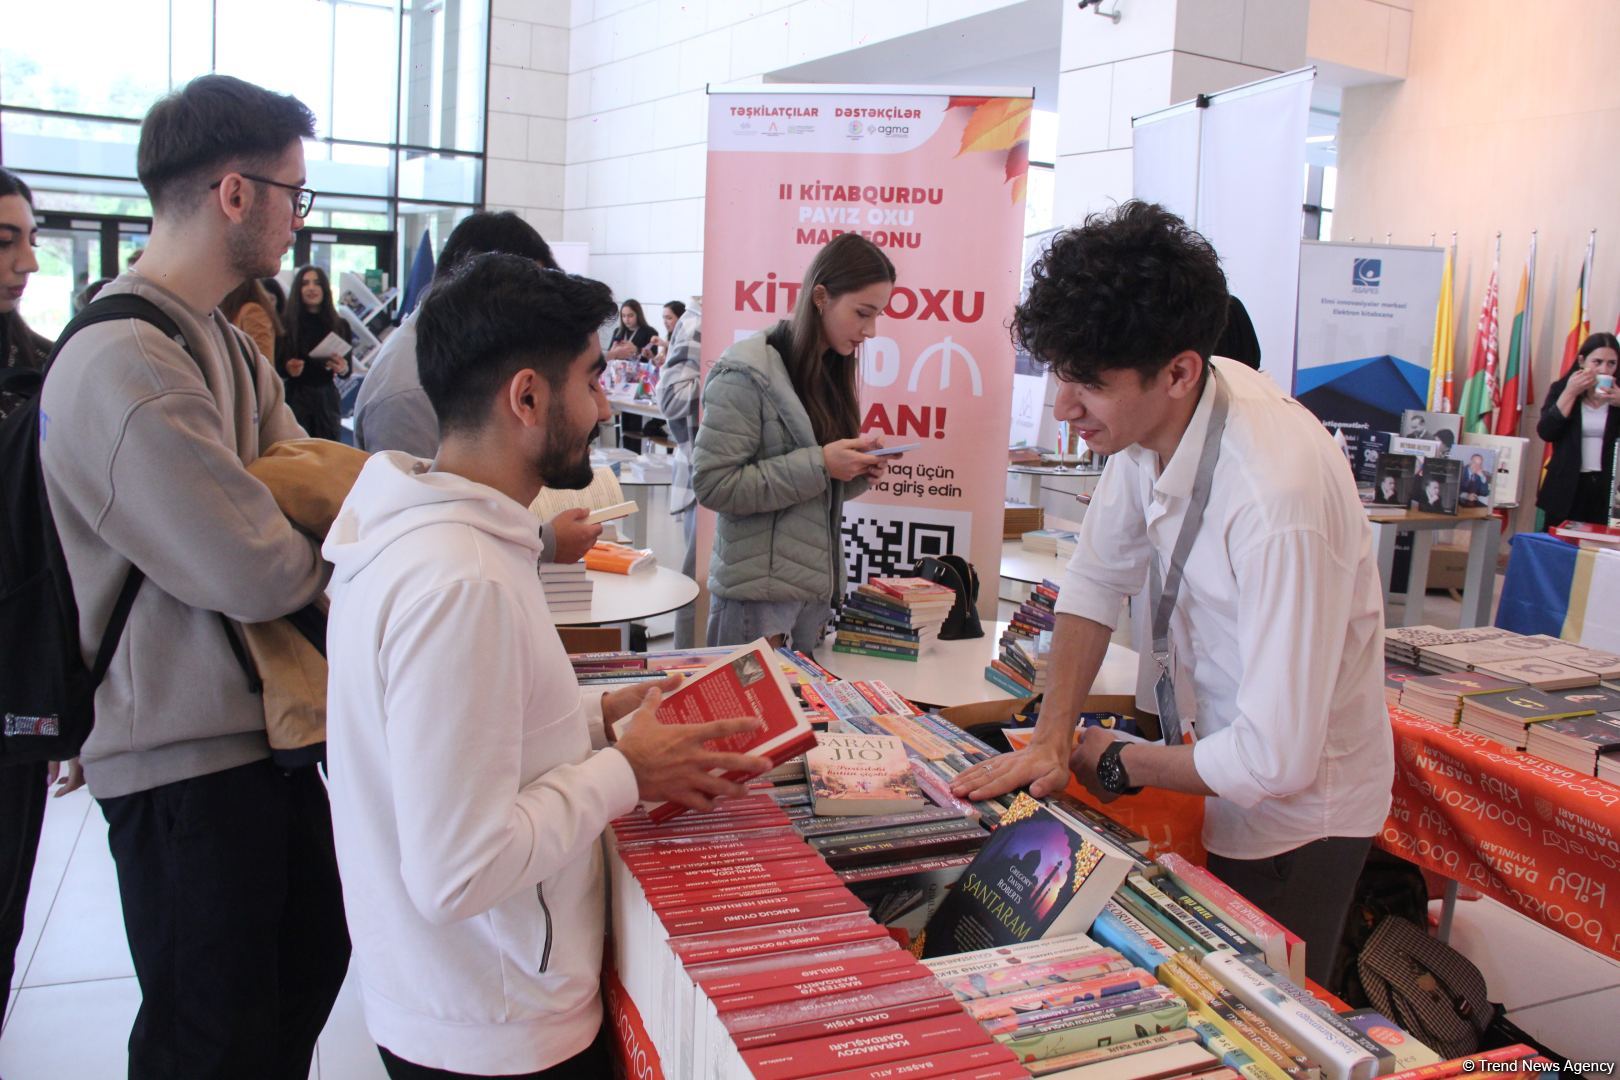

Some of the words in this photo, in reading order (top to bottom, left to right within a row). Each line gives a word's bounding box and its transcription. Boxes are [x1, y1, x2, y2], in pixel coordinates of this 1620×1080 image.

[730, 105, 819, 118] TƏŞKİLATÇILAR
[834, 107, 921, 119] DƏSTƏKÇİLƏR
[877, 124, 909, 134] agma
[779, 184, 792, 200] II
[800, 180, 943, 205] KİTABQURDU
[799, 206, 861, 224] PAYIZ
[866, 208, 914, 226] OXU
[735, 272, 803, 313] KİT
[916, 464, 954, 481] üçün
[893, 481, 924, 497] giriş
[928, 482, 962, 498] edin
[830, 748, 883, 762] JIO
[1416, 754, 1473, 785] DASTAN
[1378, 828, 1459, 872] bookzo
[1480, 839, 1537, 867] YAYINLARI
[1006, 875, 1024, 892] DAVID
[1009, 865, 1033, 888] GREGORY
[996, 879, 1023, 905] ROBERTS
[963, 874, 1032, 942] ŞANTARAM
[815, 979, 862, 993] MASTER
[823, 1016, 853, 1030] PİŞİK
[854, 1012, 889, 1024] QARA
[828, 1033, 904, 1052] QARDAŞLARI
[837, 1039, 911, 1058] KARAMAZOV
[898, 1061, 934, 1075] BAŞSIZ
